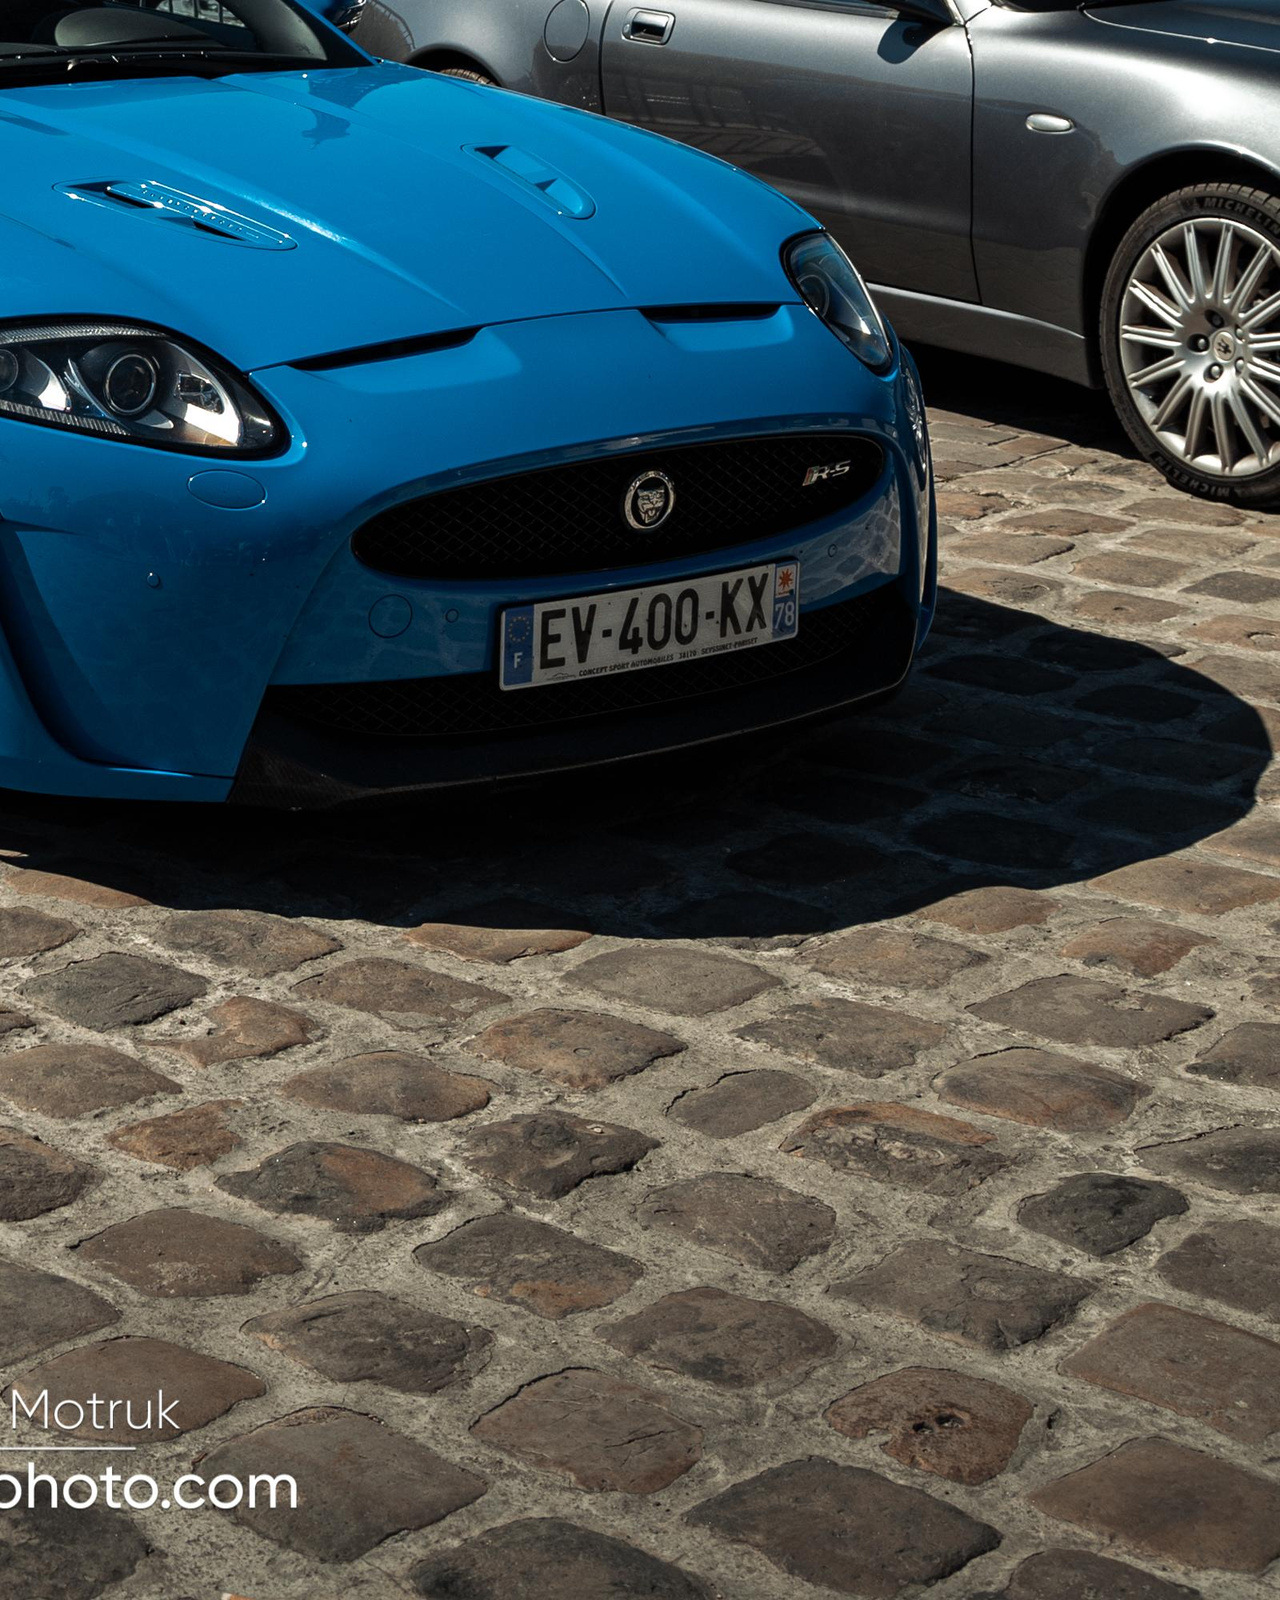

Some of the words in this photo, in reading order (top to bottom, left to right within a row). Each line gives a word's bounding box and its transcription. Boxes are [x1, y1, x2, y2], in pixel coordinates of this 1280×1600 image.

[1204, 197, 1280, 235] MICHELIN
[540, 573, 769, 670] EV-400-KX
[775, 601, 795, 629] 78
[514, 652, 523, 668] F
[579, 665, 608, 677] CONCEPT
[609, 662, 630, 672] SPORT
[630, 654, 674, 668] AUTOMOBILES
